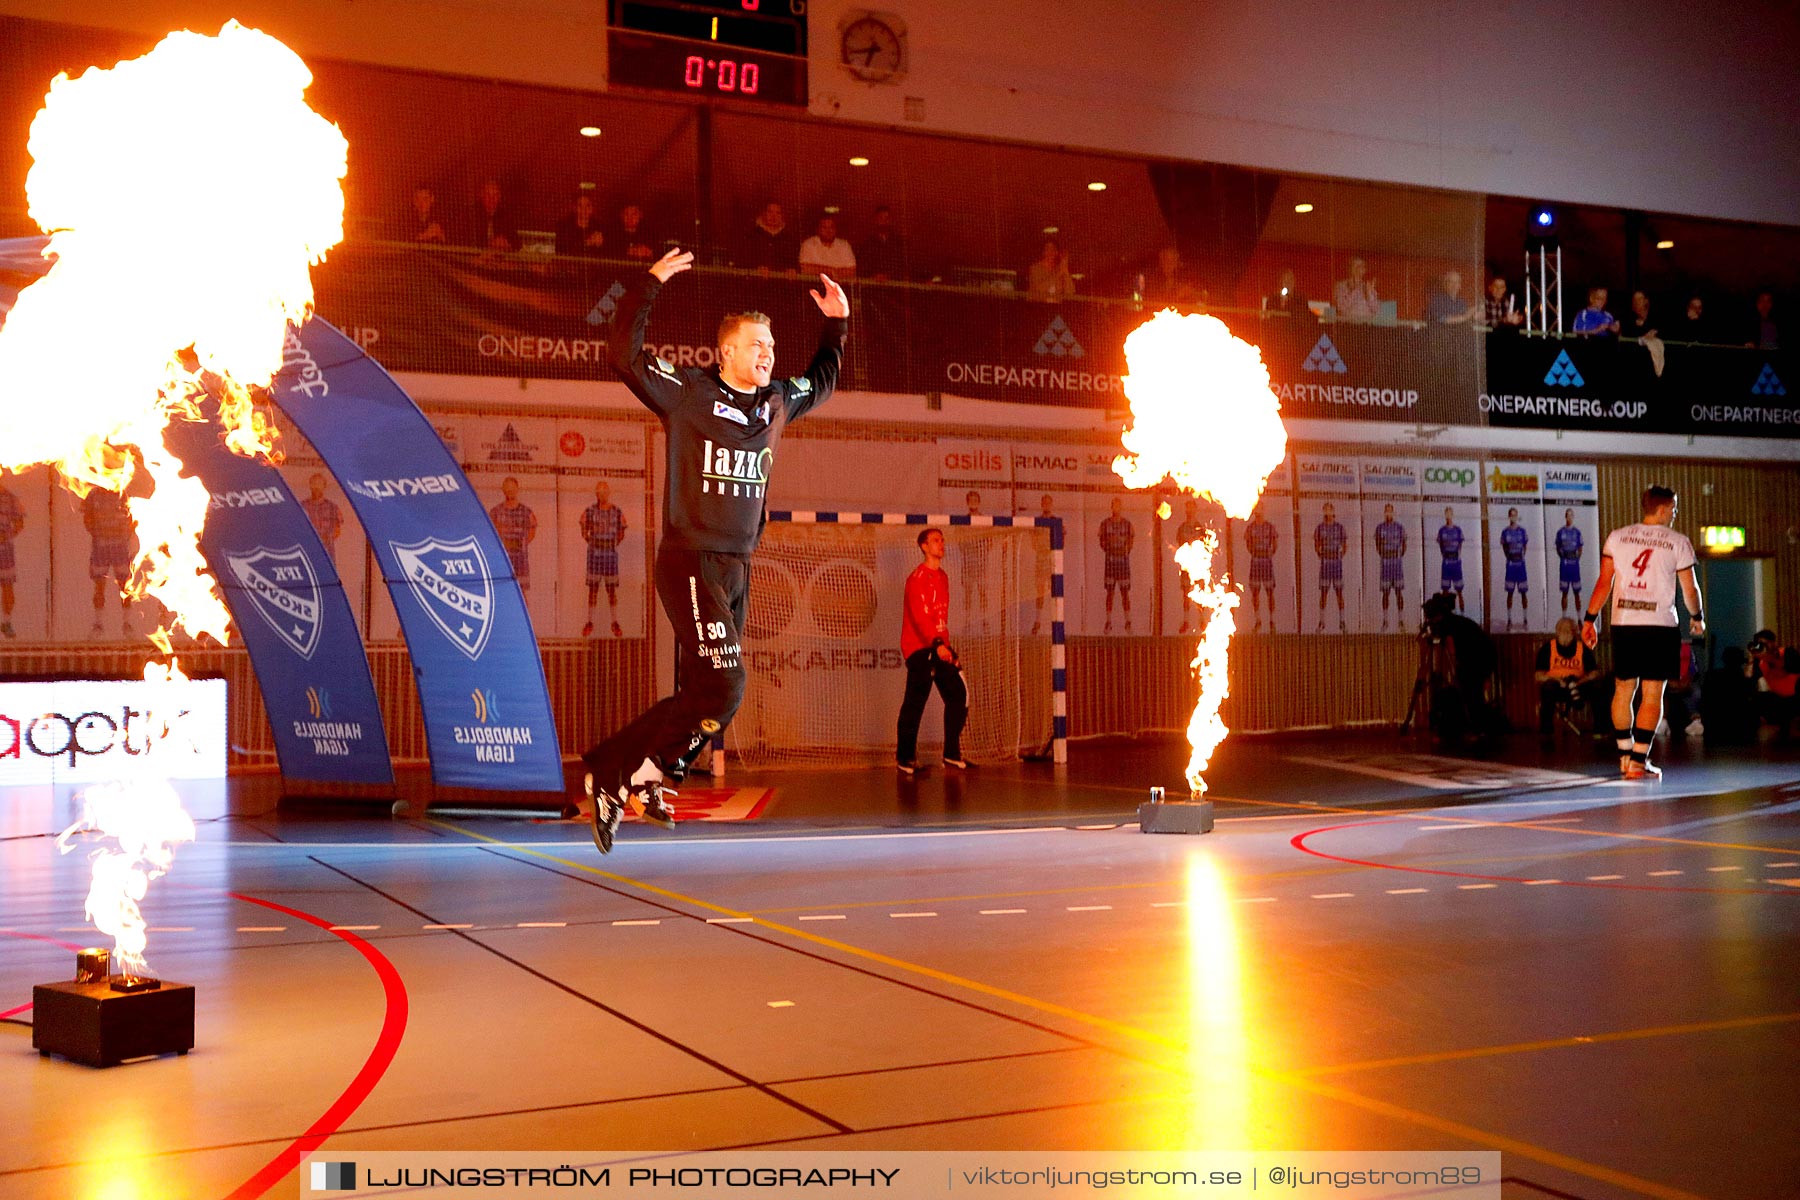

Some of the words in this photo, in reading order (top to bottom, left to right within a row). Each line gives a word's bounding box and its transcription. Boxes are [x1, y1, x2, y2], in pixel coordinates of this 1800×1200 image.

[947, 362, 1122, 393] ONEPARTNERGR
[1269, 383, 1418, 408] PARTNERGROUP
[1691, 404, 1800, 424] ONEPARTNERG
[702, 439, 774, 481] lazzo
[1424, 467, 1475, 487] coop
[1546, 470, 1592, 483] SALMING
[1632, 548, 1654, 577] 4
[706, 621, 727, 640] 30
